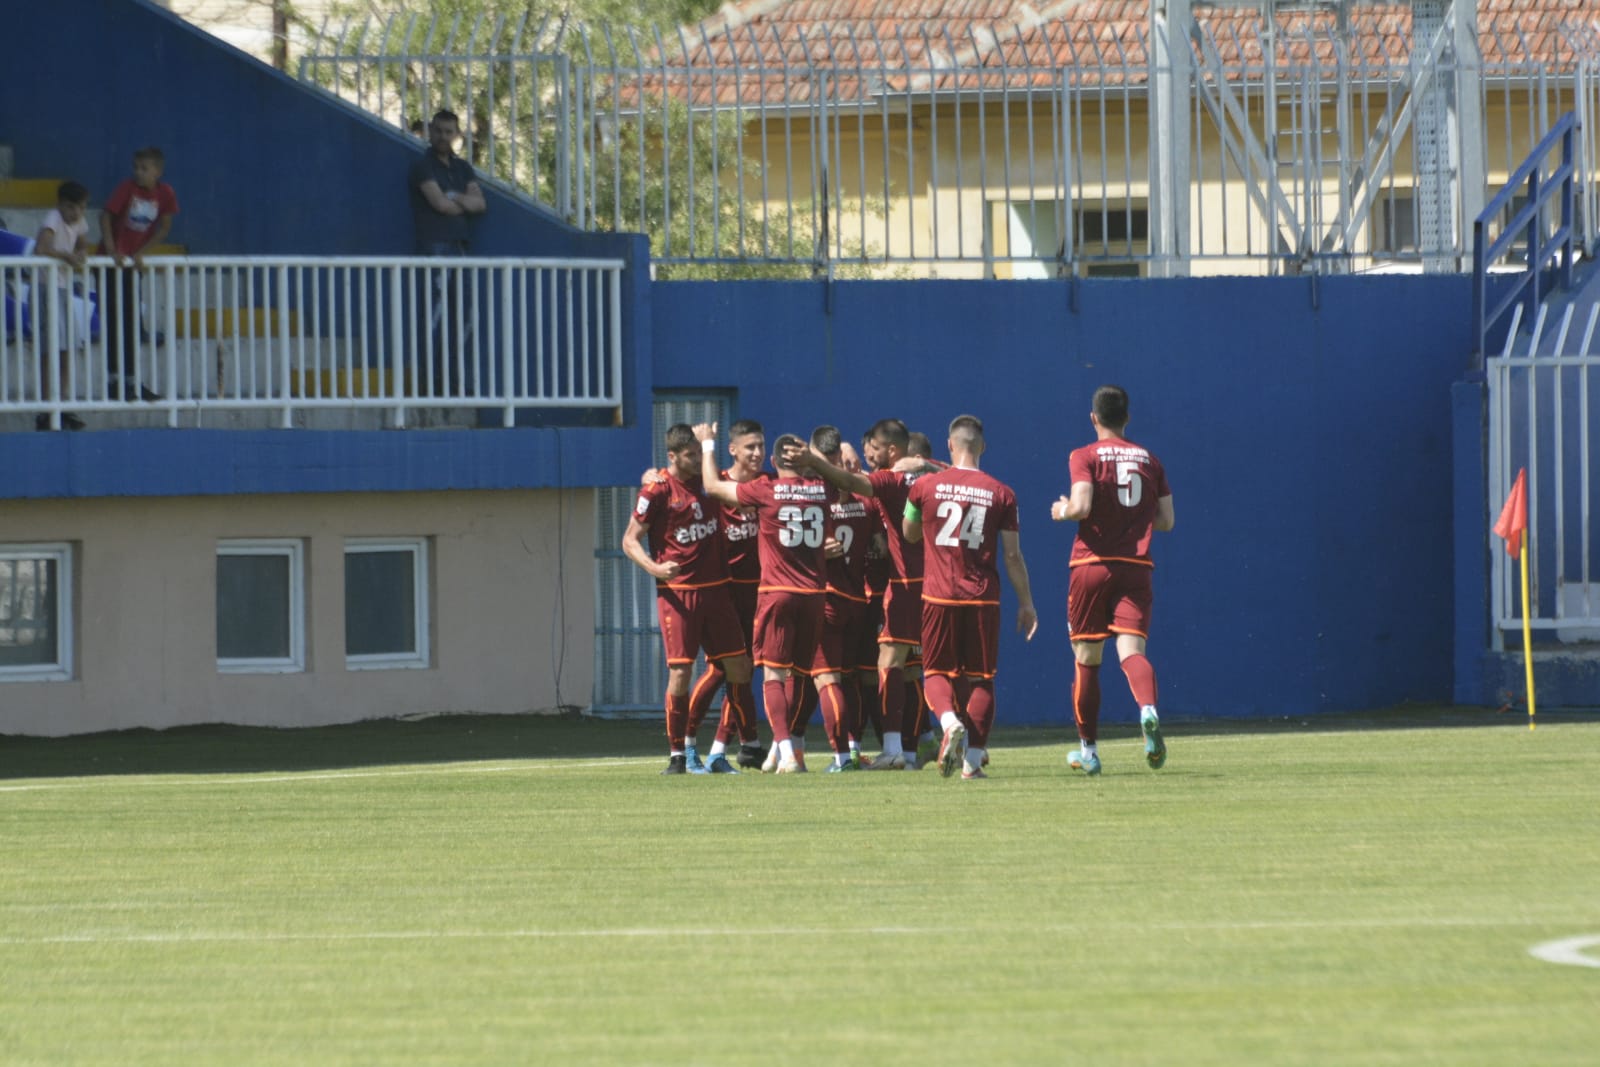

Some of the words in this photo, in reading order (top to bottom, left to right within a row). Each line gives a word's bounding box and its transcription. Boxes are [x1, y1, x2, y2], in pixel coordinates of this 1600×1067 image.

[936, 483, 953, 493] ФК
[954, 484, 994, 499] РАДНИК
[1116, 462, 1142, 507] 5
[778, 505, 824, 548] 33
[935, 501, 987, 549] 24
